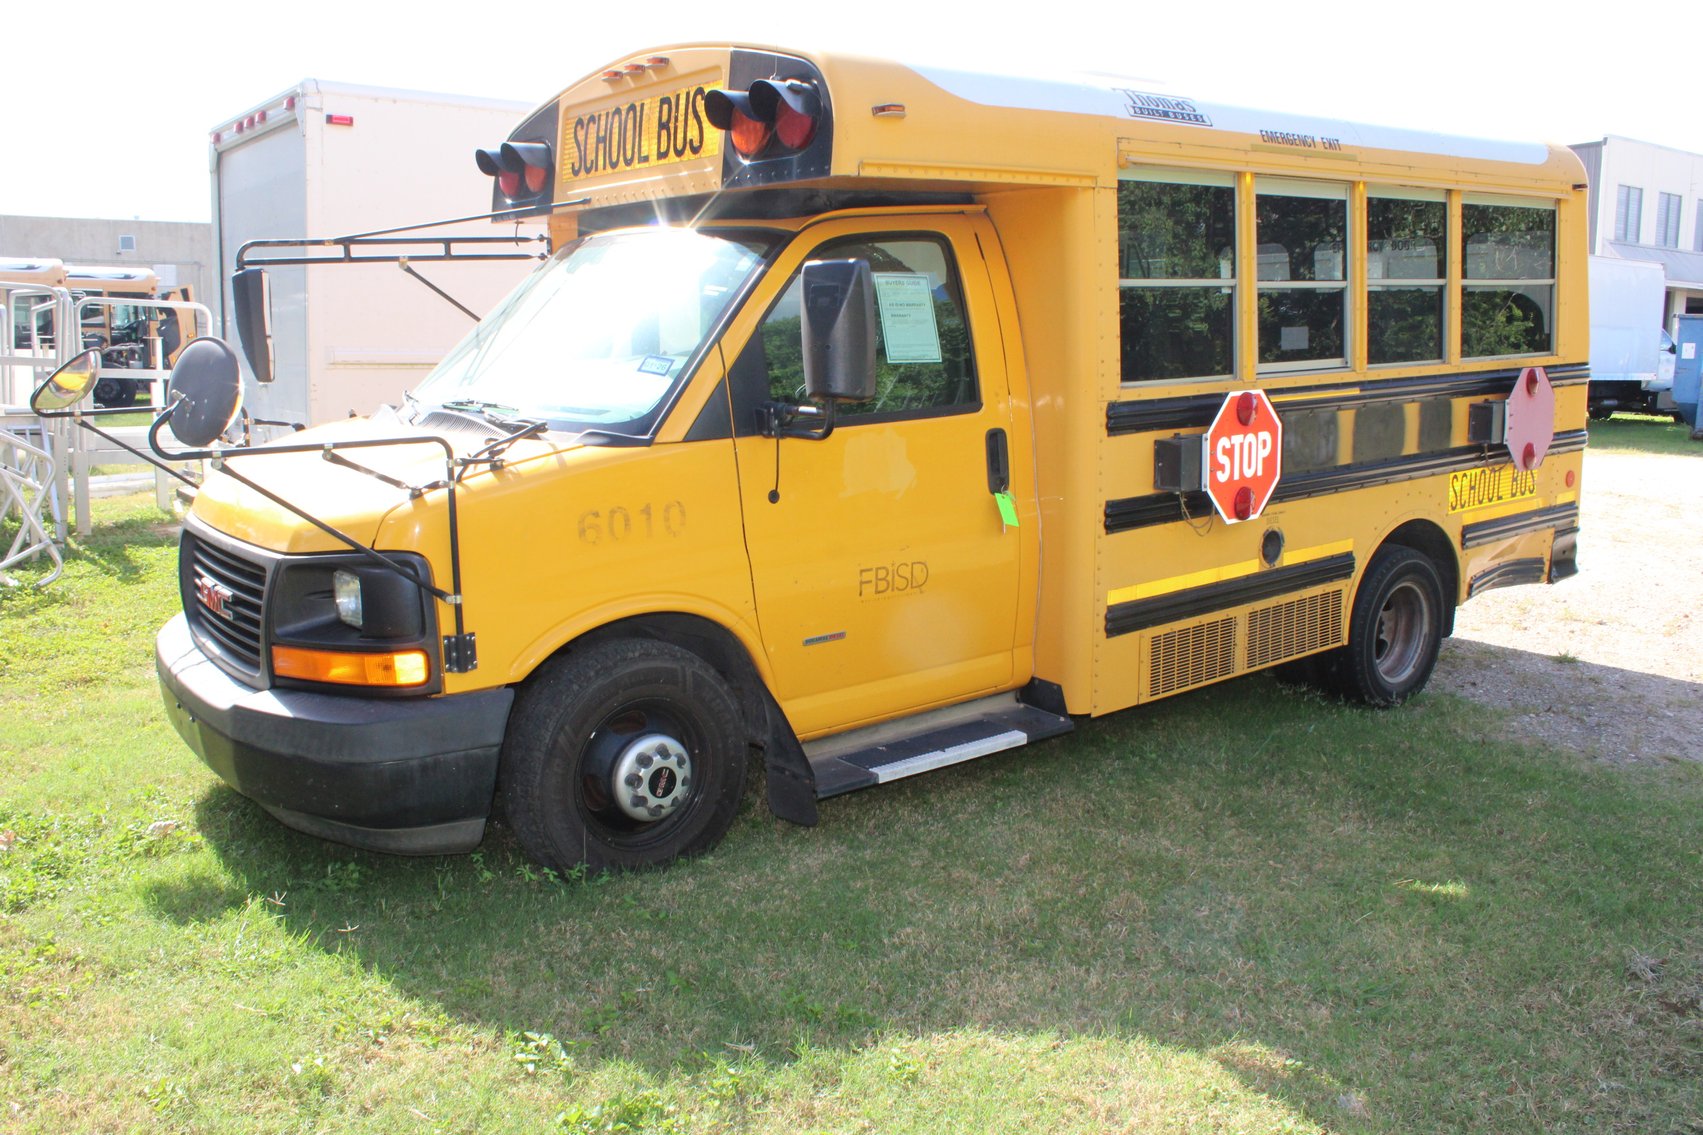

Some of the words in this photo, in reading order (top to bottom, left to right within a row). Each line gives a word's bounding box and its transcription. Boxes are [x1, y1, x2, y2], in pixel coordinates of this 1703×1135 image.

[1123, 88, 1197, 113] Thomas
[1134, 106, 1165, 117] BUILT
[1167, 111, 1204, 122] BUSES
[571, 102, 650, 177] SCHOOL
[656, 86, 706, 161] BUS
[1259, 129, 1317, 149] EMERGENCY
[1320, 136, 1342, 152] EXIT
[1216, 430, 1272, 483] STOP
[1450, 467, 1504, 512] SCHOOL
[1510, 463, 1536, 498] BUS
[577, 500, 687, 546] 6010
[655, 767, 670, 797] GMC
